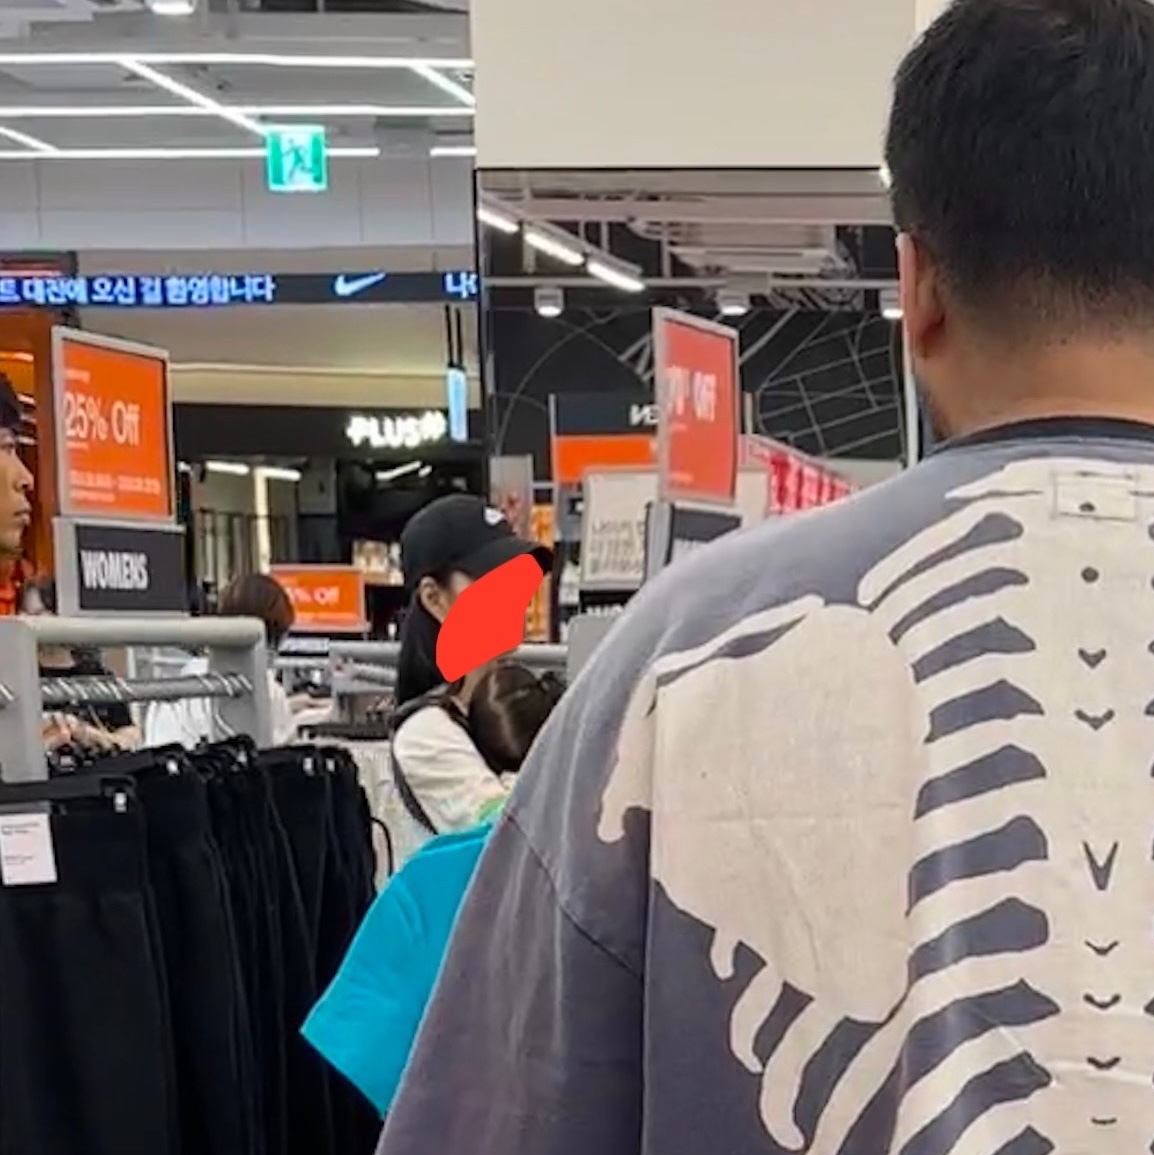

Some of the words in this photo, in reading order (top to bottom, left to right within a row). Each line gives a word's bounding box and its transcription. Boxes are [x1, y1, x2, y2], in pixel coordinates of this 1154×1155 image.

[92, 276, 136, 303] 오신
[64, 391, 110, 442] 25%
[110, 400, 140, 446] Off
[80, 549, 150, 591] WOMENS
